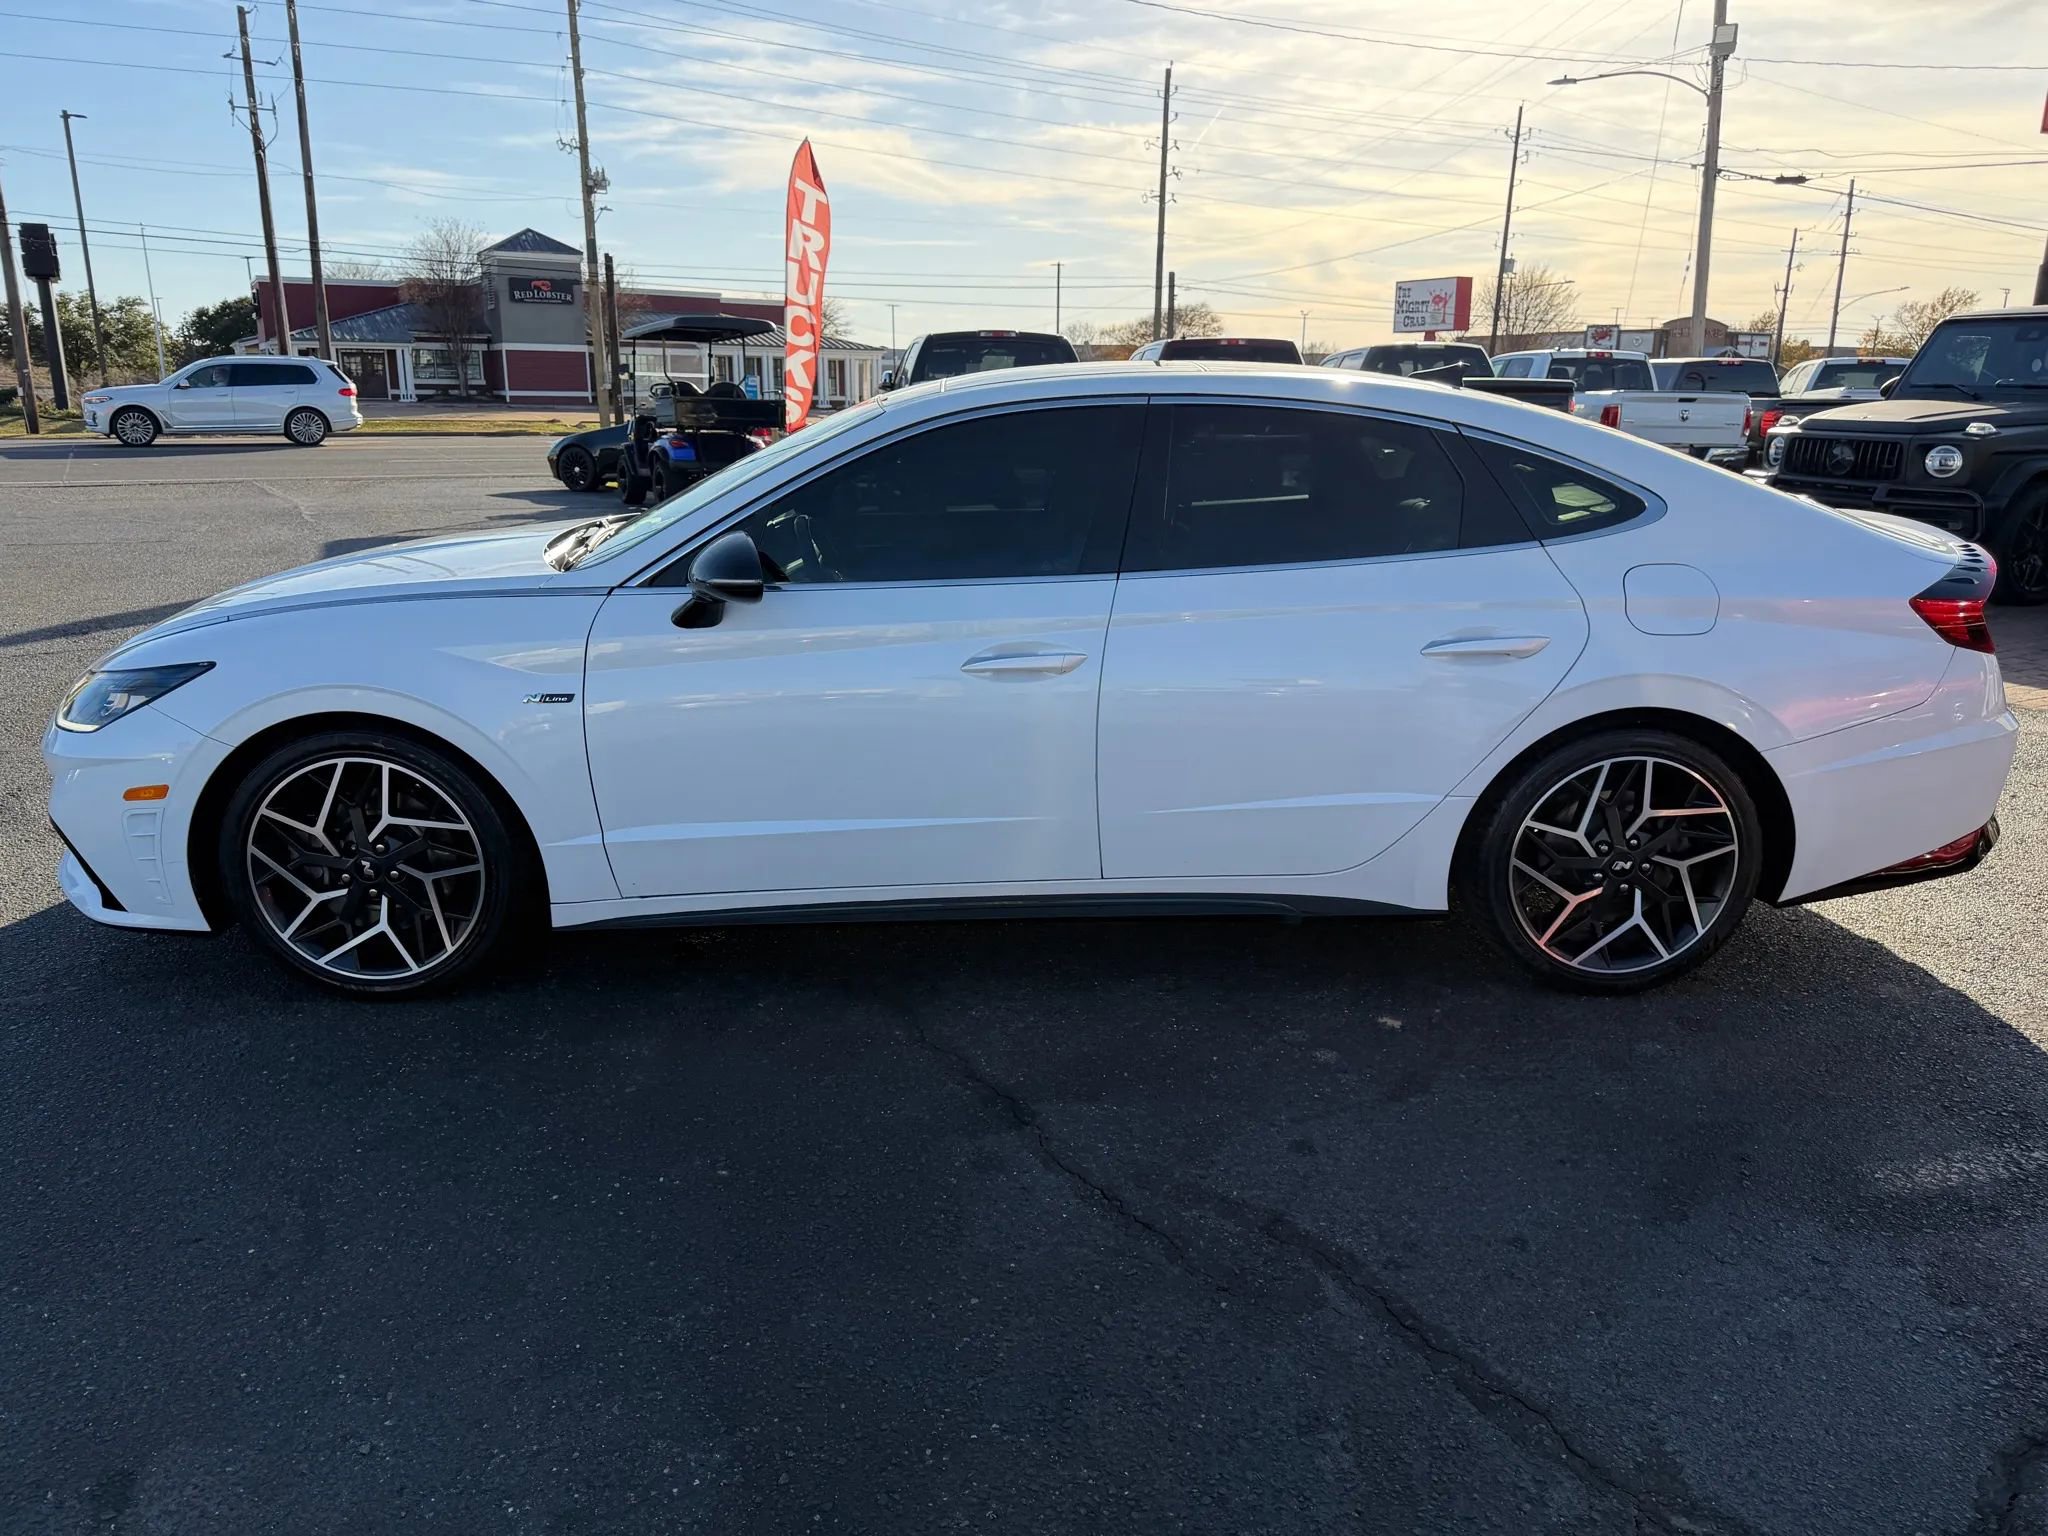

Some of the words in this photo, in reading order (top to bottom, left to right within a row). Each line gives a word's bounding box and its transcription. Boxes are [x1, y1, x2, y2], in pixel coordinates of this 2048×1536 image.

[514, 290, 533, 300] RED
[533, 289, 572, 302] LOBSTER
[785, 177, 828, 425] TRUCKS
